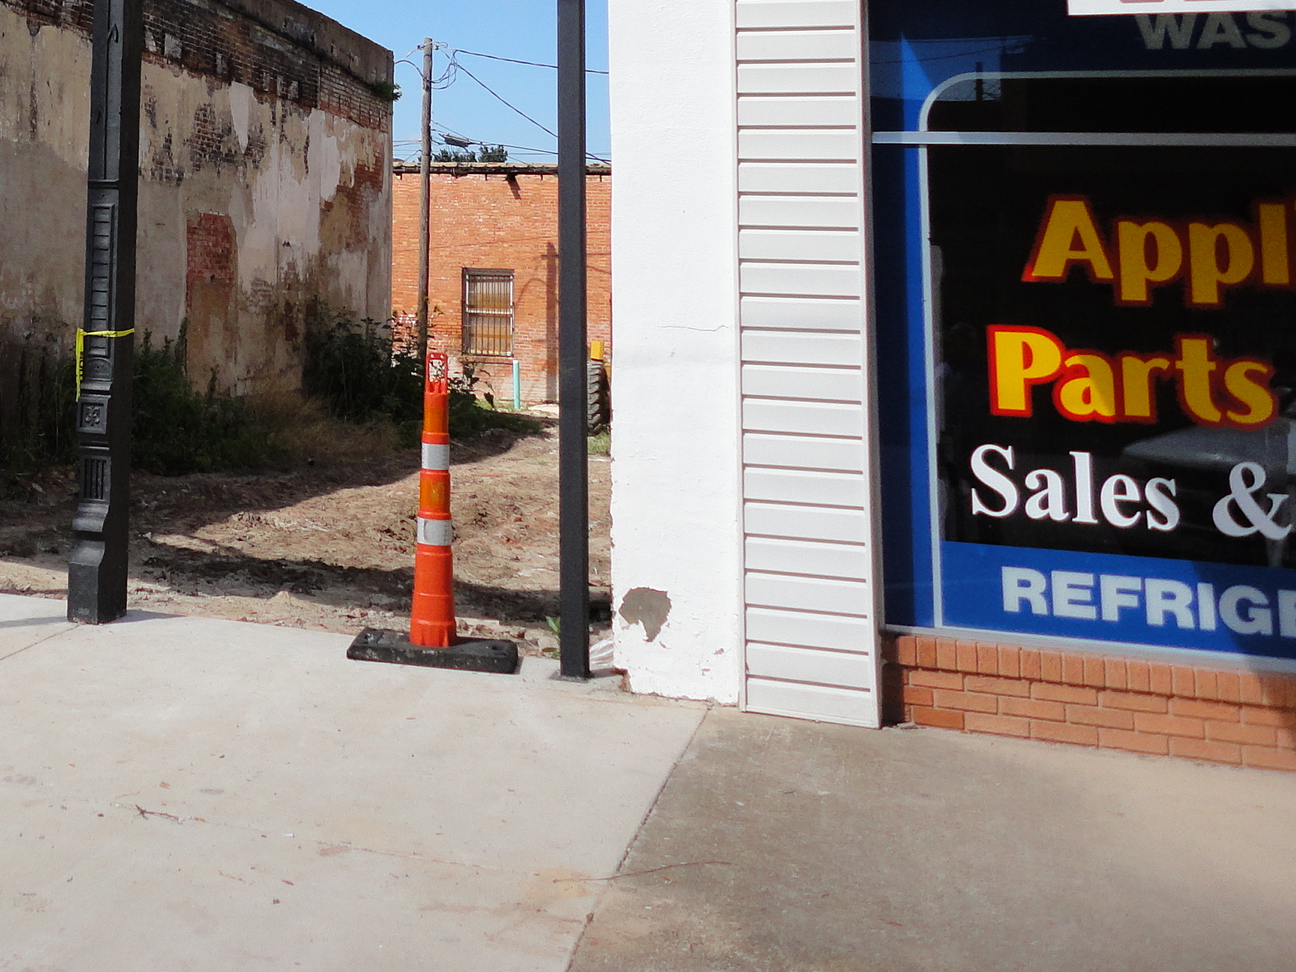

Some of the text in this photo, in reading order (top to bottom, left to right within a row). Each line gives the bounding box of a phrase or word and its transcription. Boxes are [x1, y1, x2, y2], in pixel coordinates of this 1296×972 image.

[1134, 12, 1292, 51] WAS
[1023, 196, 1296, 307] Appl
[987, 325, 1278, 429] Parts
[970, 444, 1296, 540] Sales &
